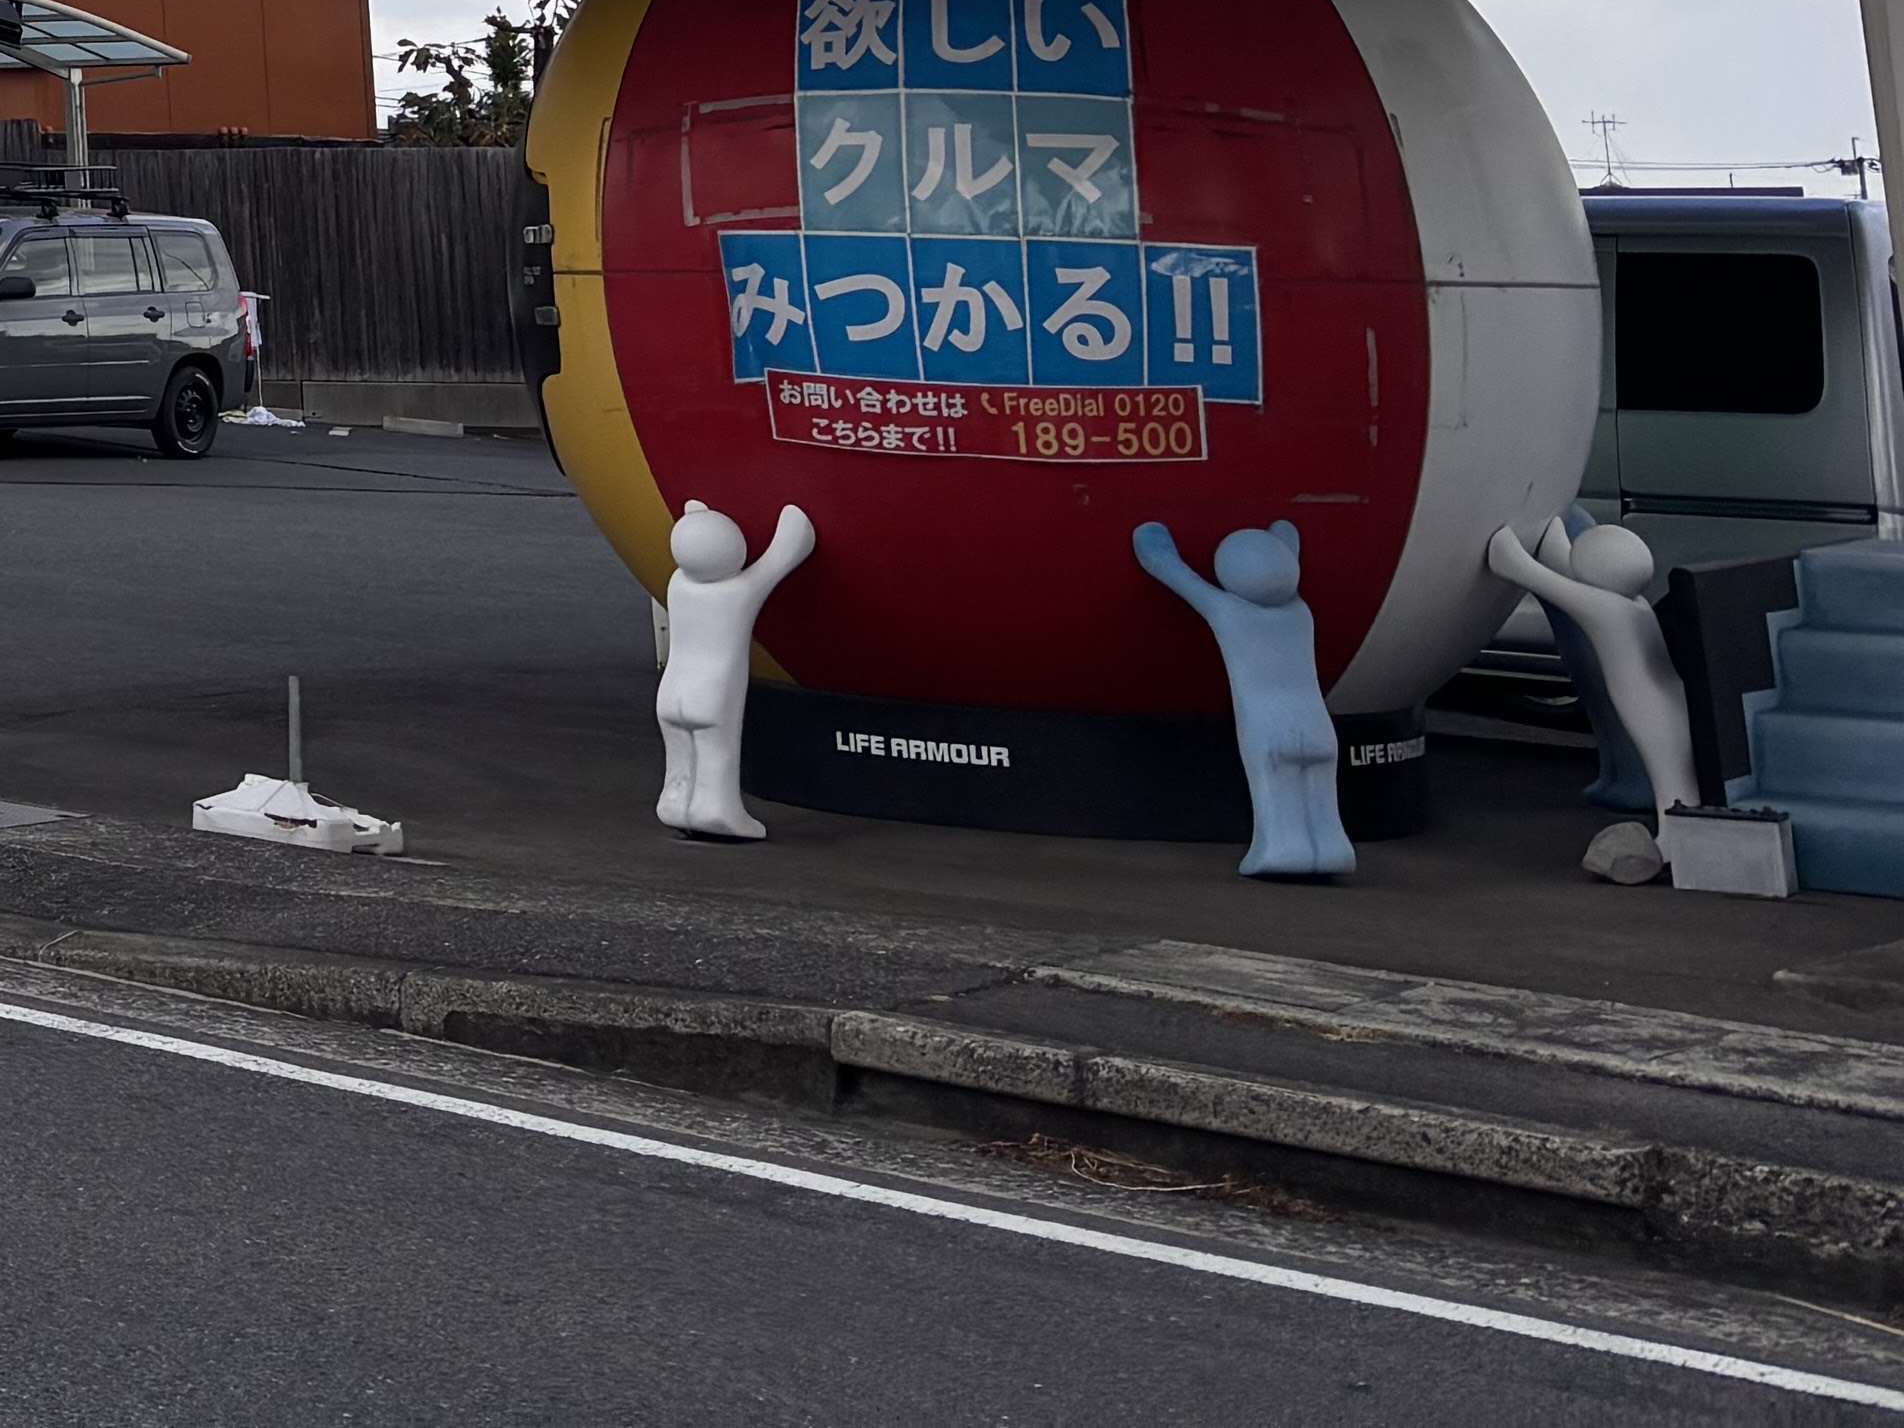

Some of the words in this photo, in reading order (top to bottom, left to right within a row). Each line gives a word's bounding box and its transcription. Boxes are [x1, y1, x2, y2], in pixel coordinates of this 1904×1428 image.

[809, 116, 1121, 206] クルマ
[729, 260, 1234, 365] みつかる!!
[779, 381, 969, 419] お問い合わせは
[1003, 392, 1105, 417] FreeDial
[1114, 393, 1185, 417] 0120
[810, 417, 958, 453] こちらまで!!
[1010, 421, 1193, 457] 189-500
[835, 730, 886, 757] LIFE
[892, 737, 1011, 768] ARMOUR
[1350, 743, 1385, 766] LIFE
